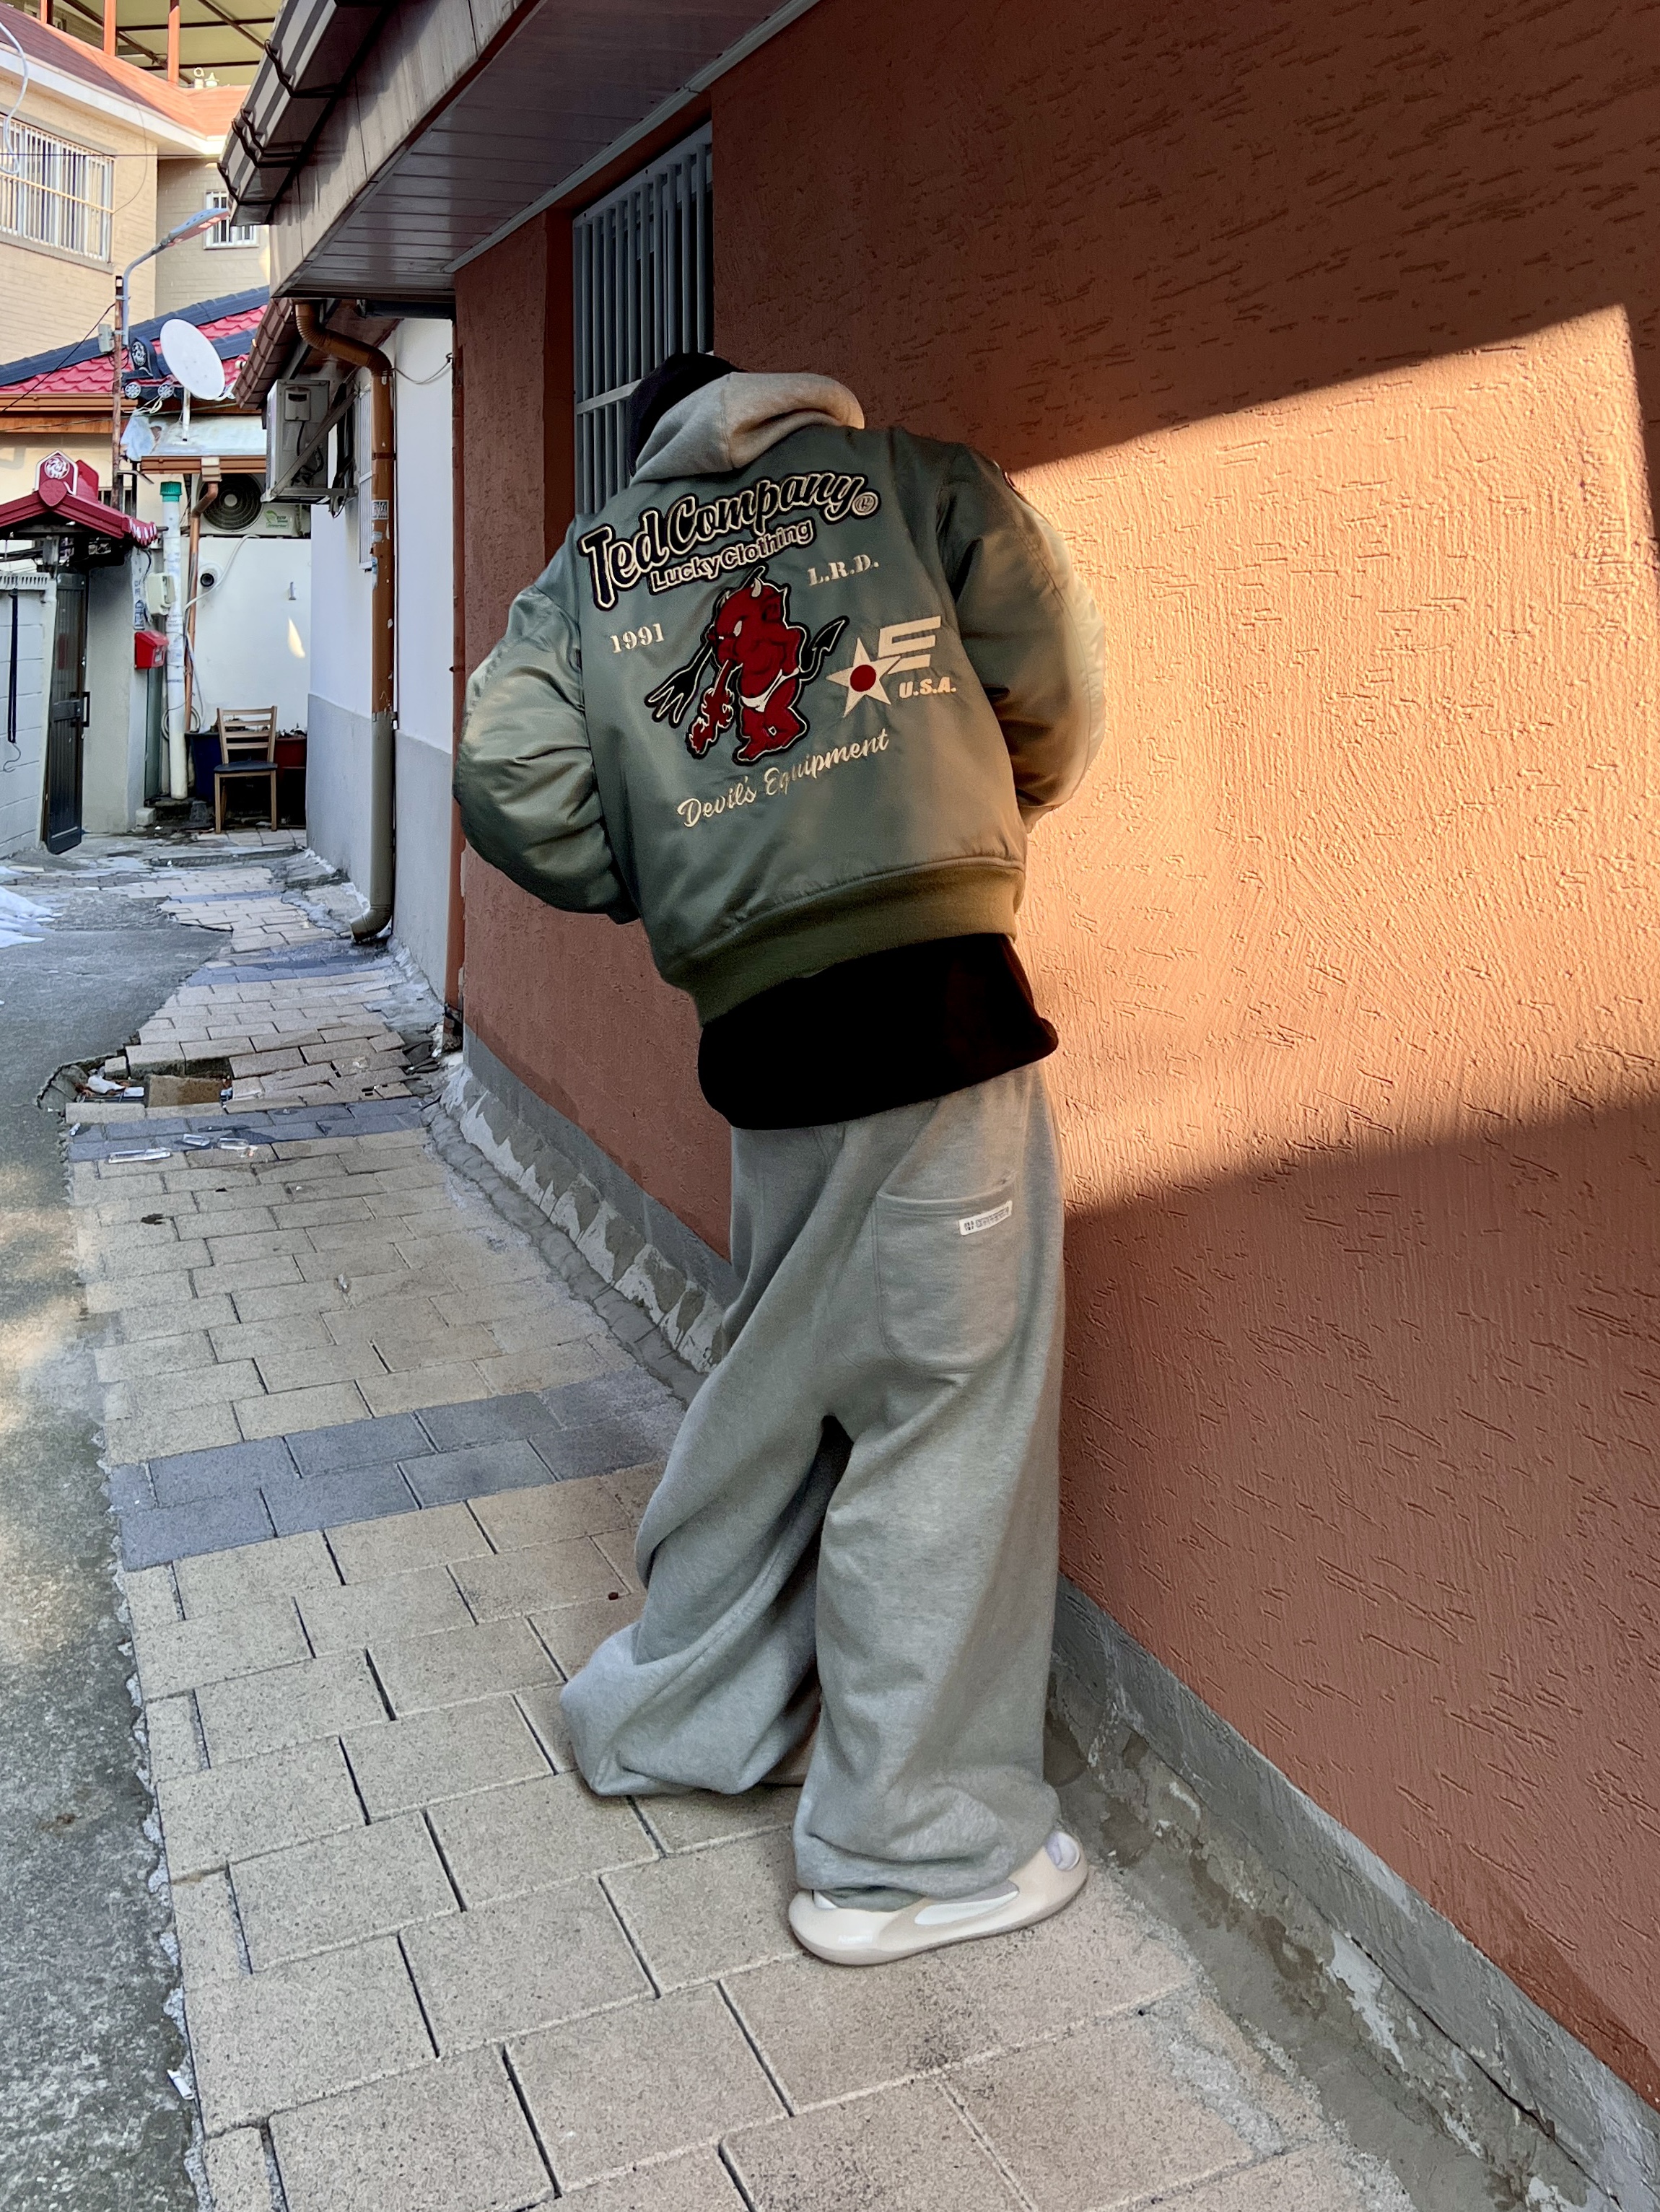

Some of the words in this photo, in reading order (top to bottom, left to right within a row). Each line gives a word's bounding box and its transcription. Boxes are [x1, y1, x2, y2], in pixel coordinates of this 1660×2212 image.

[581, 510, 670, 608] Ted
[650, 556, 721, 593] Lucky
[720, 519, 814, 570] Clothing
[807, 554, 880, 587] L.R.D.
[609, 622, 665, 655] 1991
[899, 676, 958, 699] U.S.A.
[676, 775, 757, 828] Devil's
[763, 727, 890, 796] Equipment
